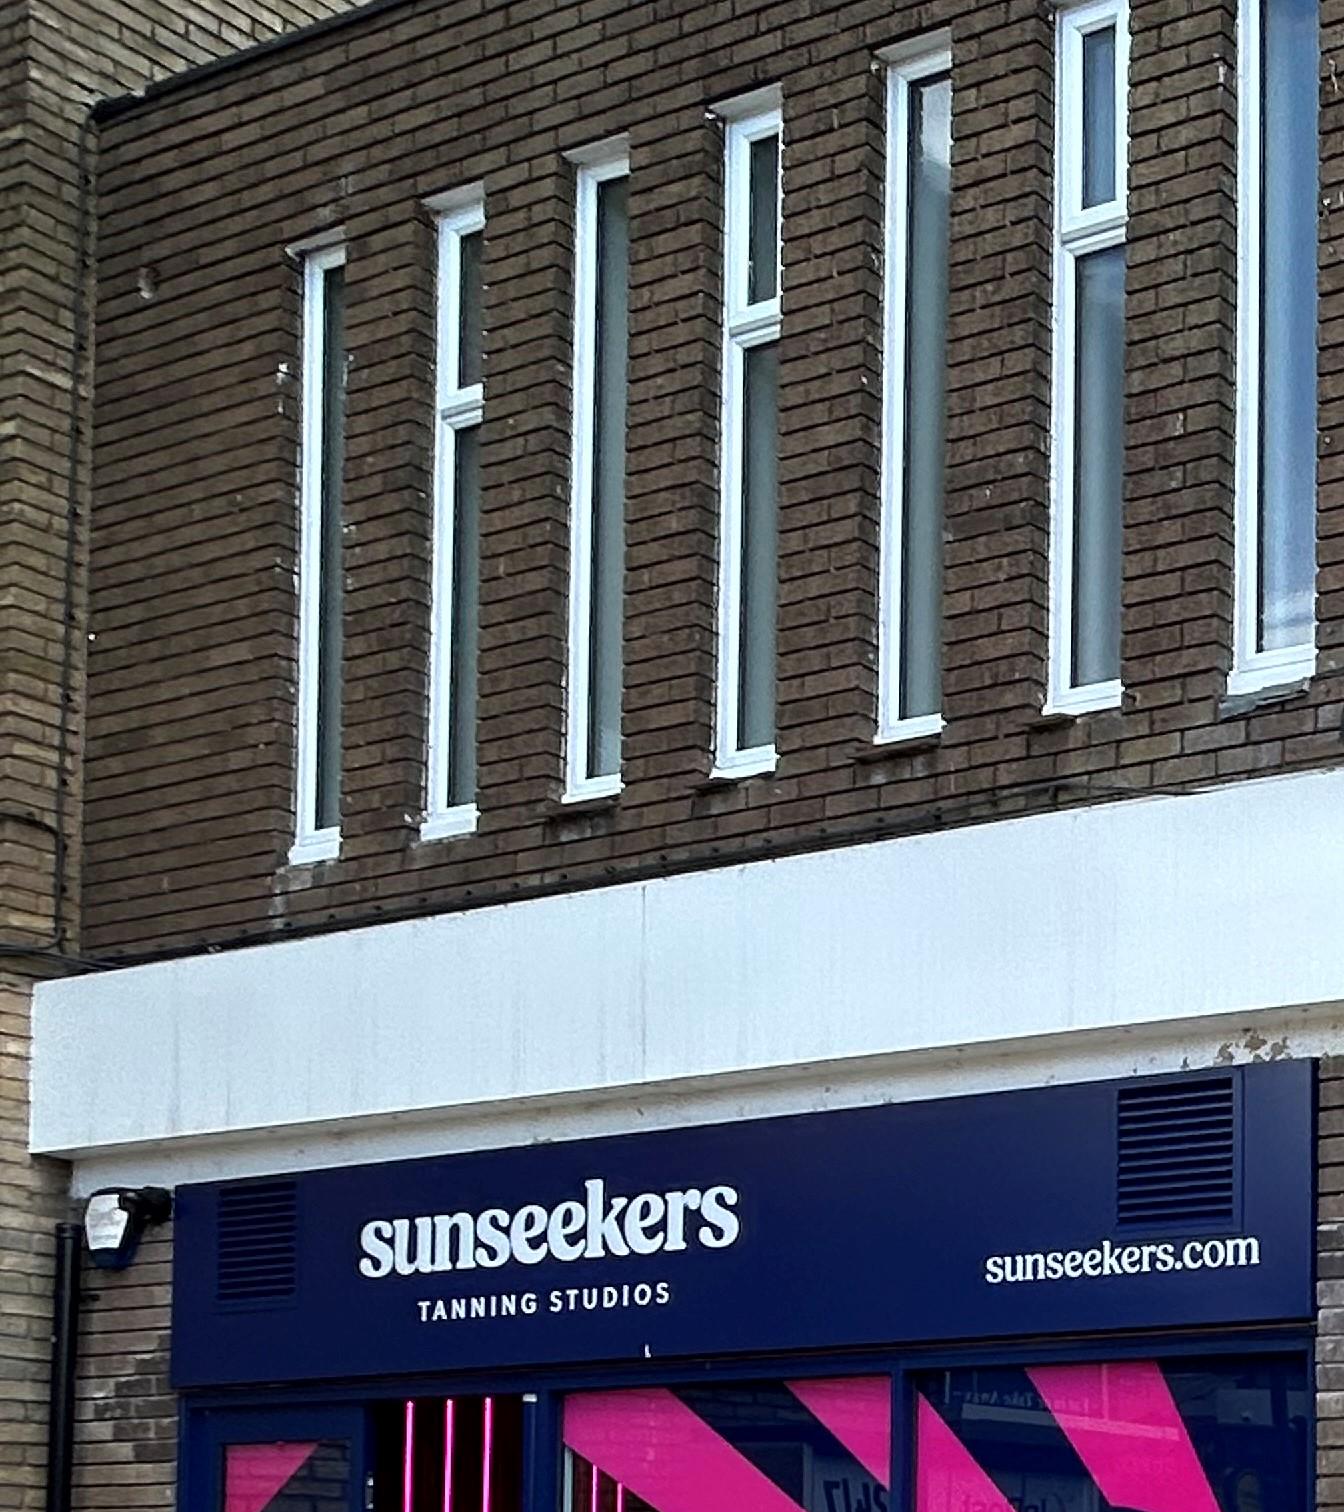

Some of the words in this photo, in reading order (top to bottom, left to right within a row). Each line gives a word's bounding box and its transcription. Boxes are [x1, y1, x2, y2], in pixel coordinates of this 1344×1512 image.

[358, 1178, 740, 1278] sunseekers
[985, 1236, 1260, 1283] sunseekers.com
[417, 1291, 538, 1322] TANNING
[549, 1282, 670, 1312] STUDIOS
